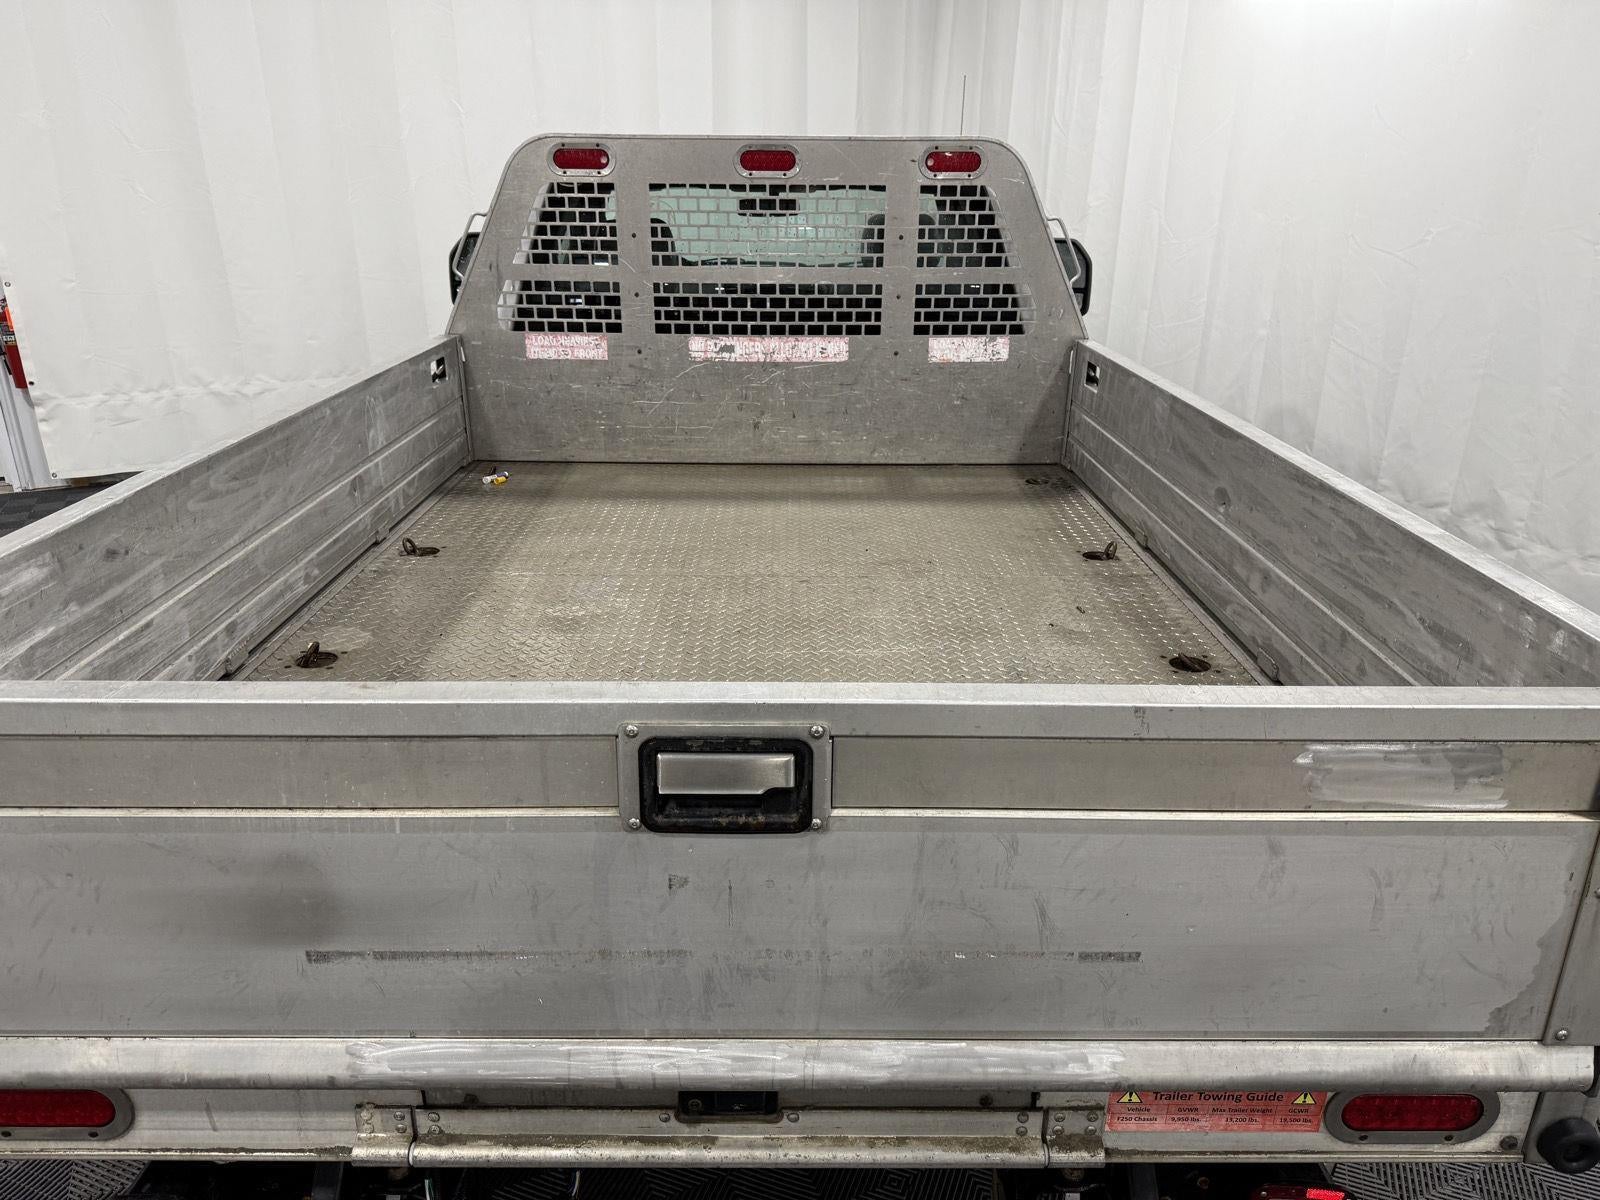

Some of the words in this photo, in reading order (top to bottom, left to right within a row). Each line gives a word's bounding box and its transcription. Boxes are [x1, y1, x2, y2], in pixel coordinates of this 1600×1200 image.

[1152, 1091, 1194, 1101] Trailer
[1197, 1091, 1243, 1103] Towing
[1246, 1092, 1284, 1102] Guide
